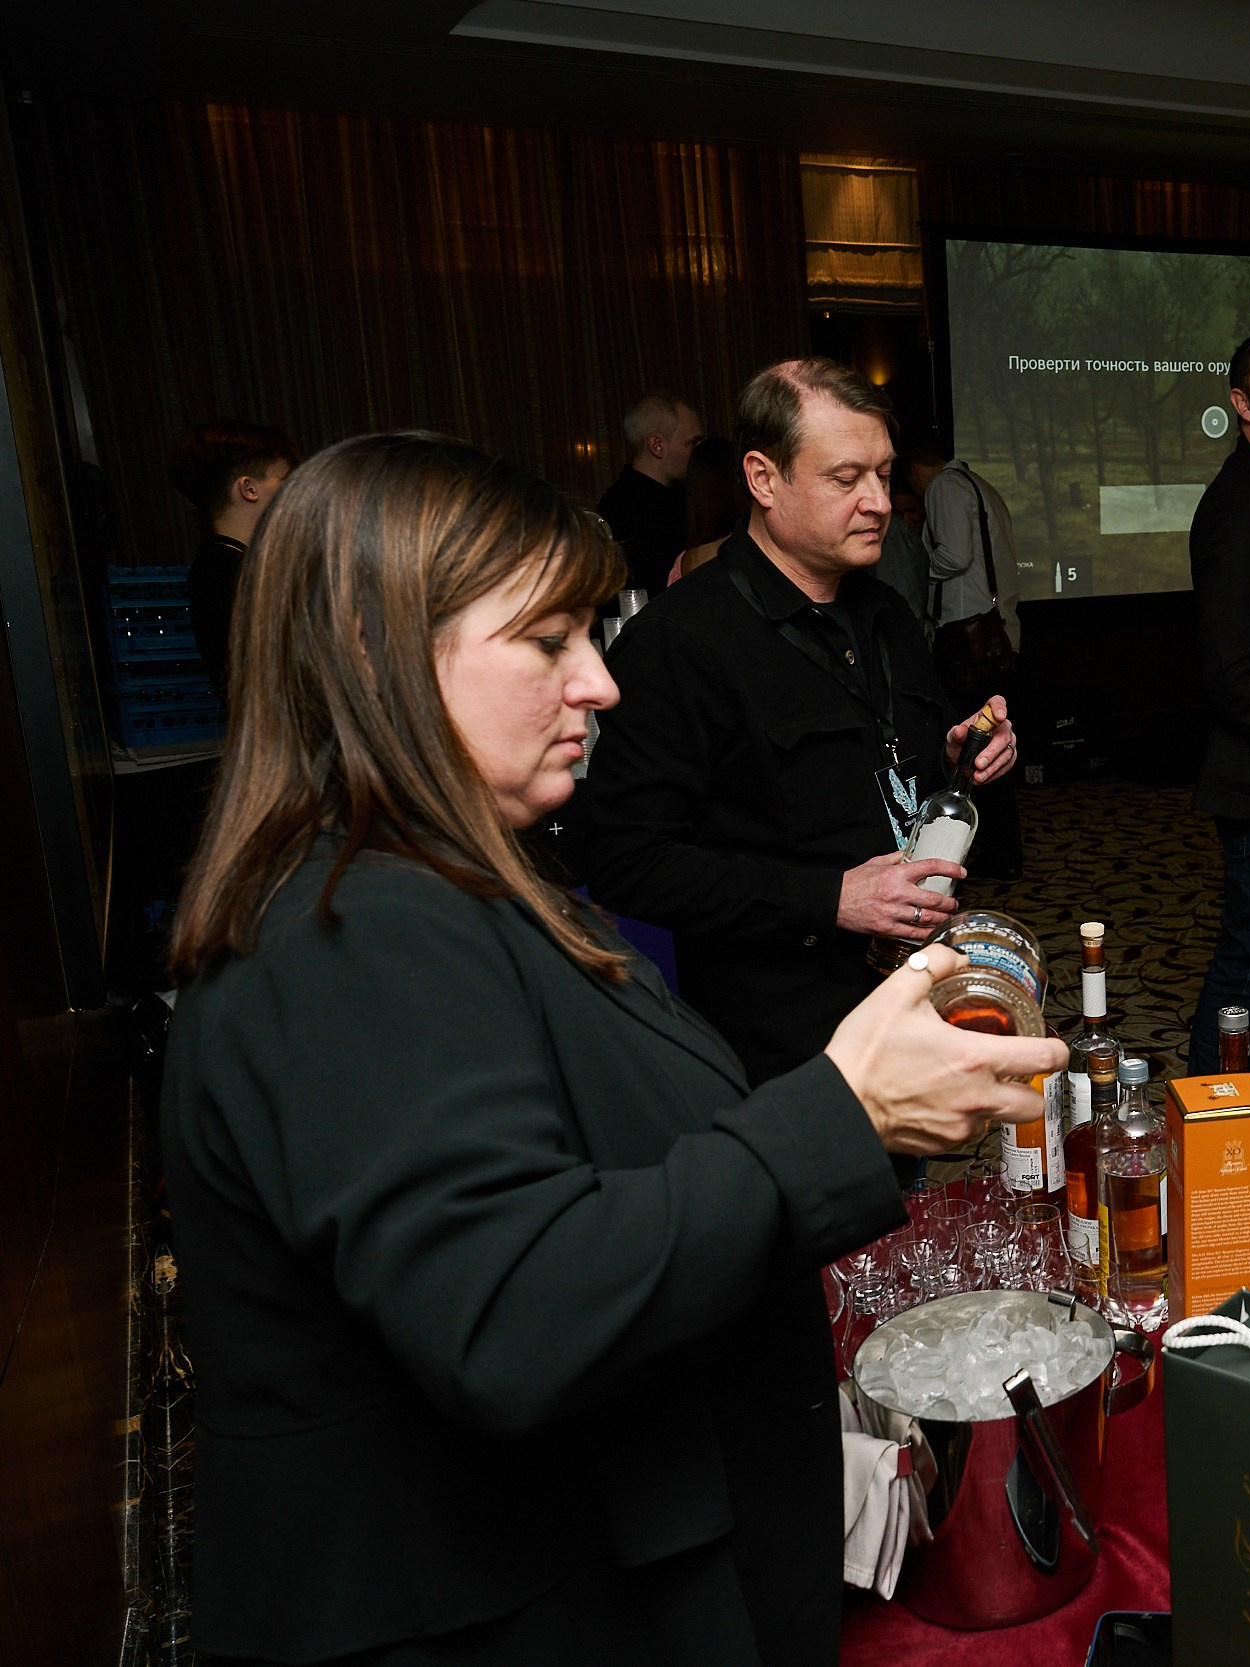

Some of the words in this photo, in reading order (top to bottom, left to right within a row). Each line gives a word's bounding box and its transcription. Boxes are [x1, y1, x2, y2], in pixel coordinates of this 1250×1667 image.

[1008, 355, 1080, 374] Проверти
[1085, 358, 1150, 372] точность
[1154, 359, 1204, 373] вашего
[1207, 360, 1231, 376] ору
[1067, 567, 1077, 581] 5
[1225, 1147, 1242, 1157] XO
